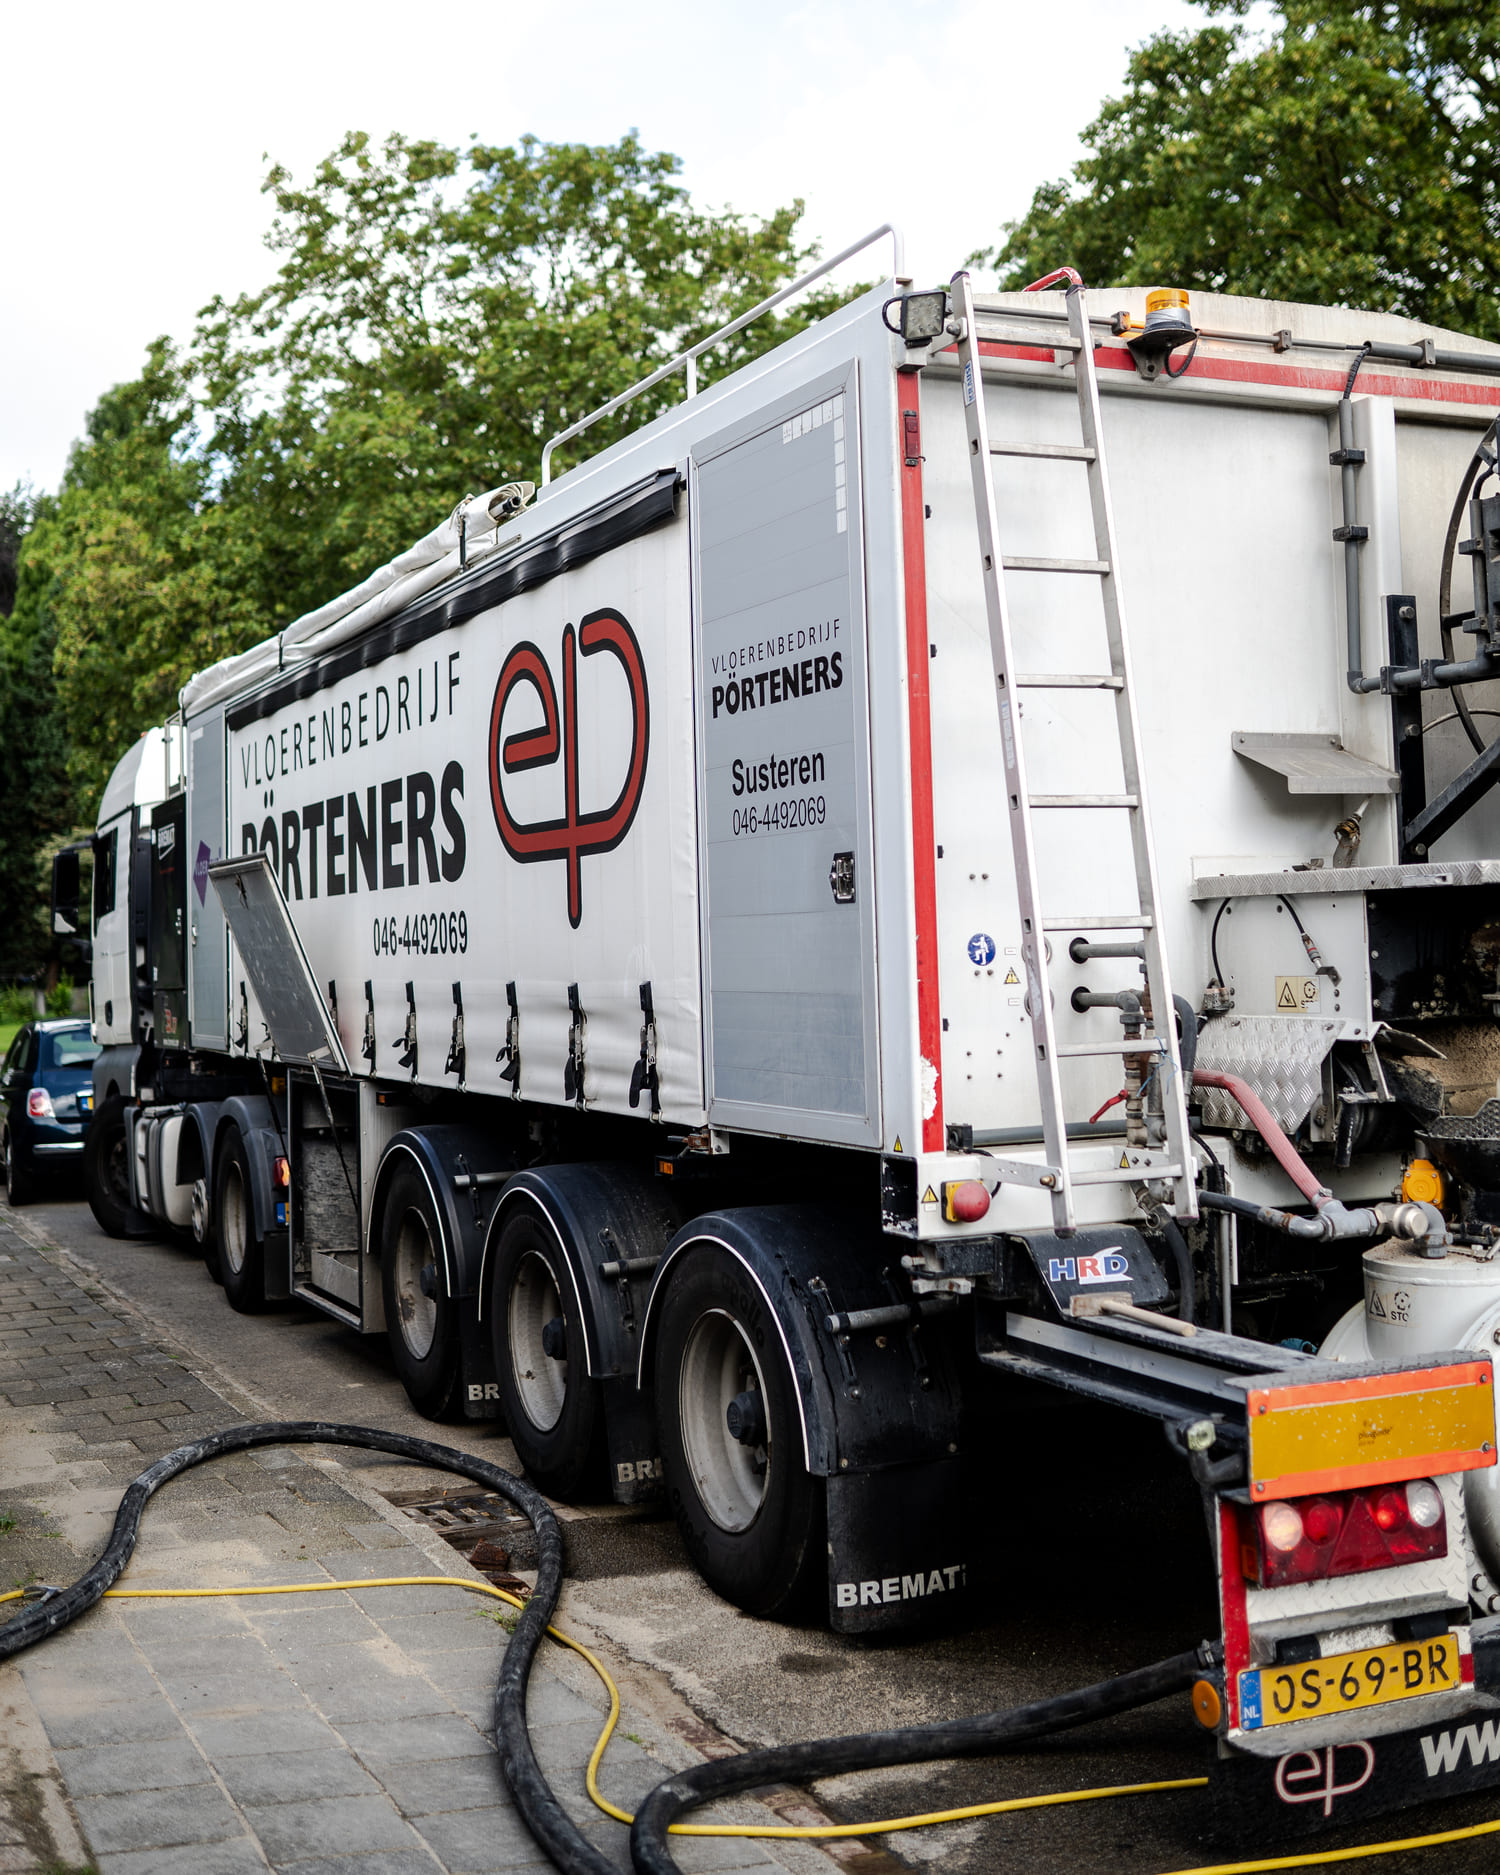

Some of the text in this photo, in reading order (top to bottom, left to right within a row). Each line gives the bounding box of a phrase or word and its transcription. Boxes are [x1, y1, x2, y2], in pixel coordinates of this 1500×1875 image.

[712, 618, 840, 674] VLOERENBEDRIJF
[712, 651, 843, 719] PÖRTENERS
[241, 651, 461, 789] VLOERENBEDRIJF
[732, 752, 825, 796] Susteren
[732, 795, 826, 836] 046-4492069
[373, 910, 468, 956] 046-4492069
[1049, 1253, 1129, 1282] HRD
[1243, 1704, 1260, 1720] NL
